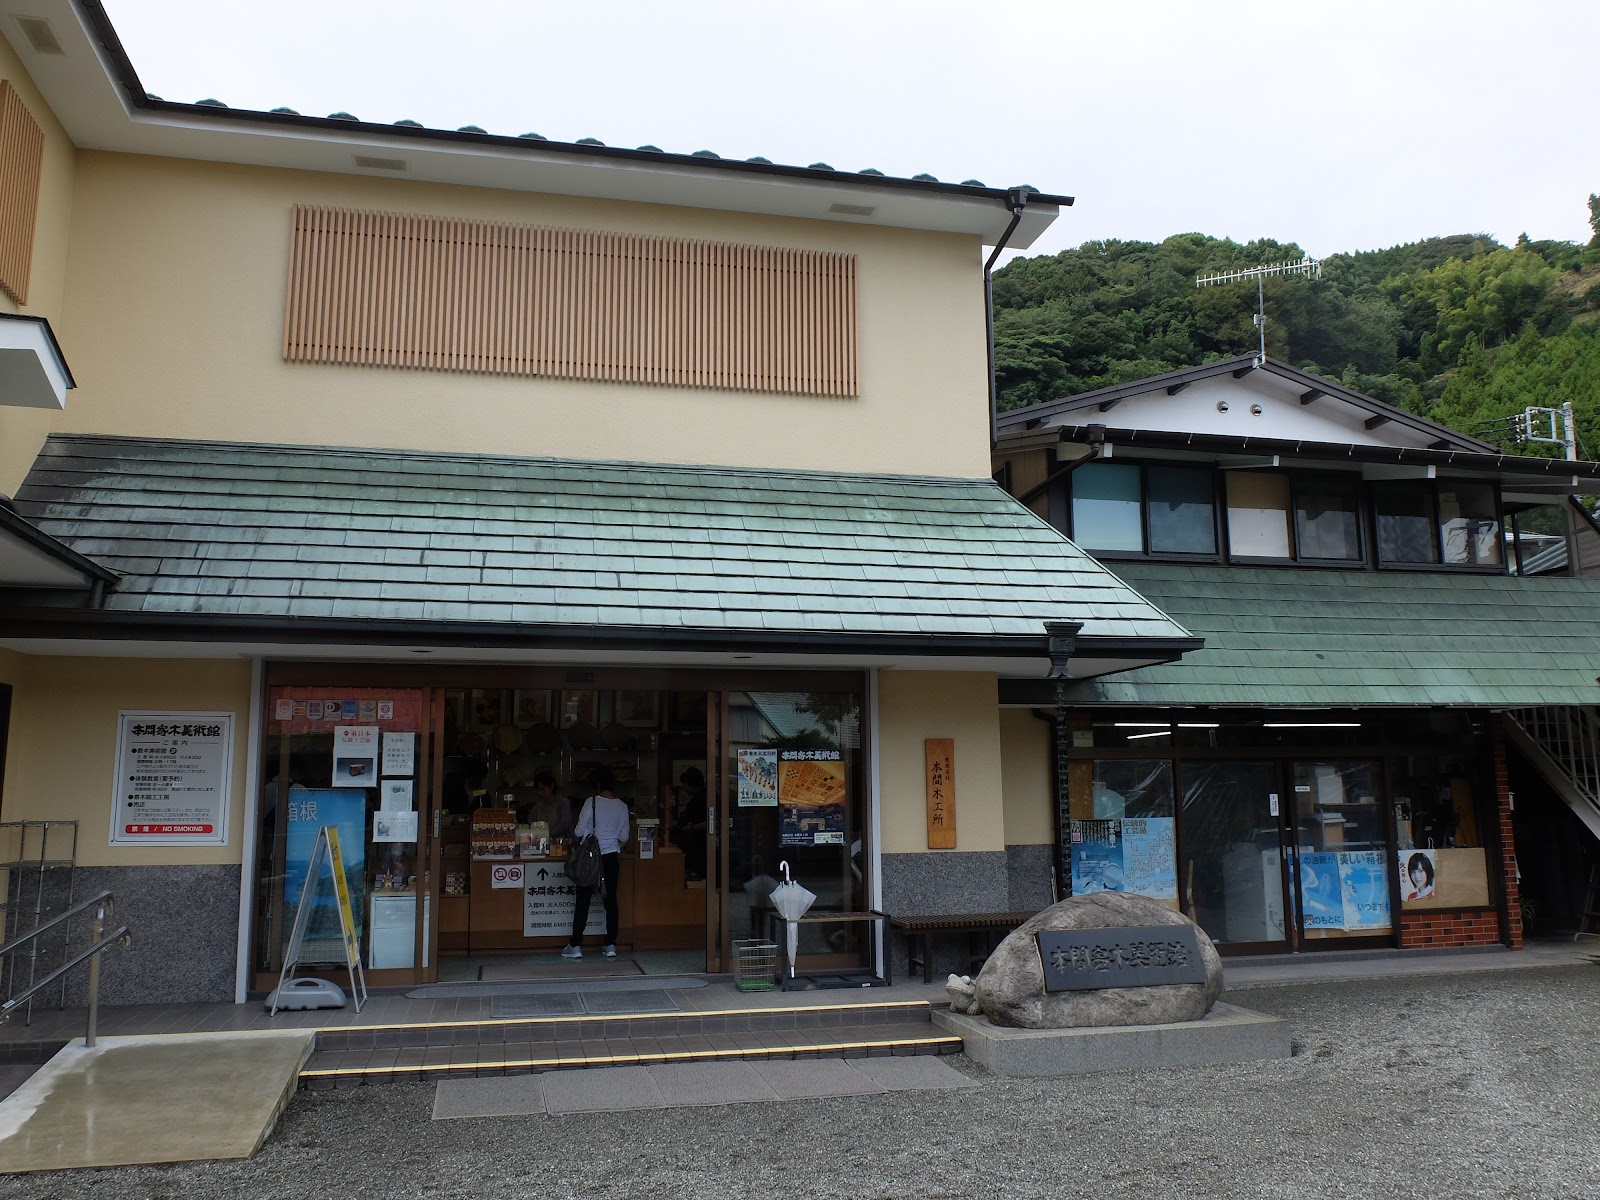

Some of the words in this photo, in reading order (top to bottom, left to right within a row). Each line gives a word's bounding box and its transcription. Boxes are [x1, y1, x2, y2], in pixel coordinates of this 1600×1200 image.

[132, 724, 220, 737] 本間寄木美術館
[781, 750, 840, 761] 本間寄木美術館
[931, 760, 944, 827] 本間木工所
[1123, 819, 1147, 827] 伝統的
[1123, 827, 1147, 835] 工芸品
[1050, 941, 1189, 974] 本間寄木美術館
